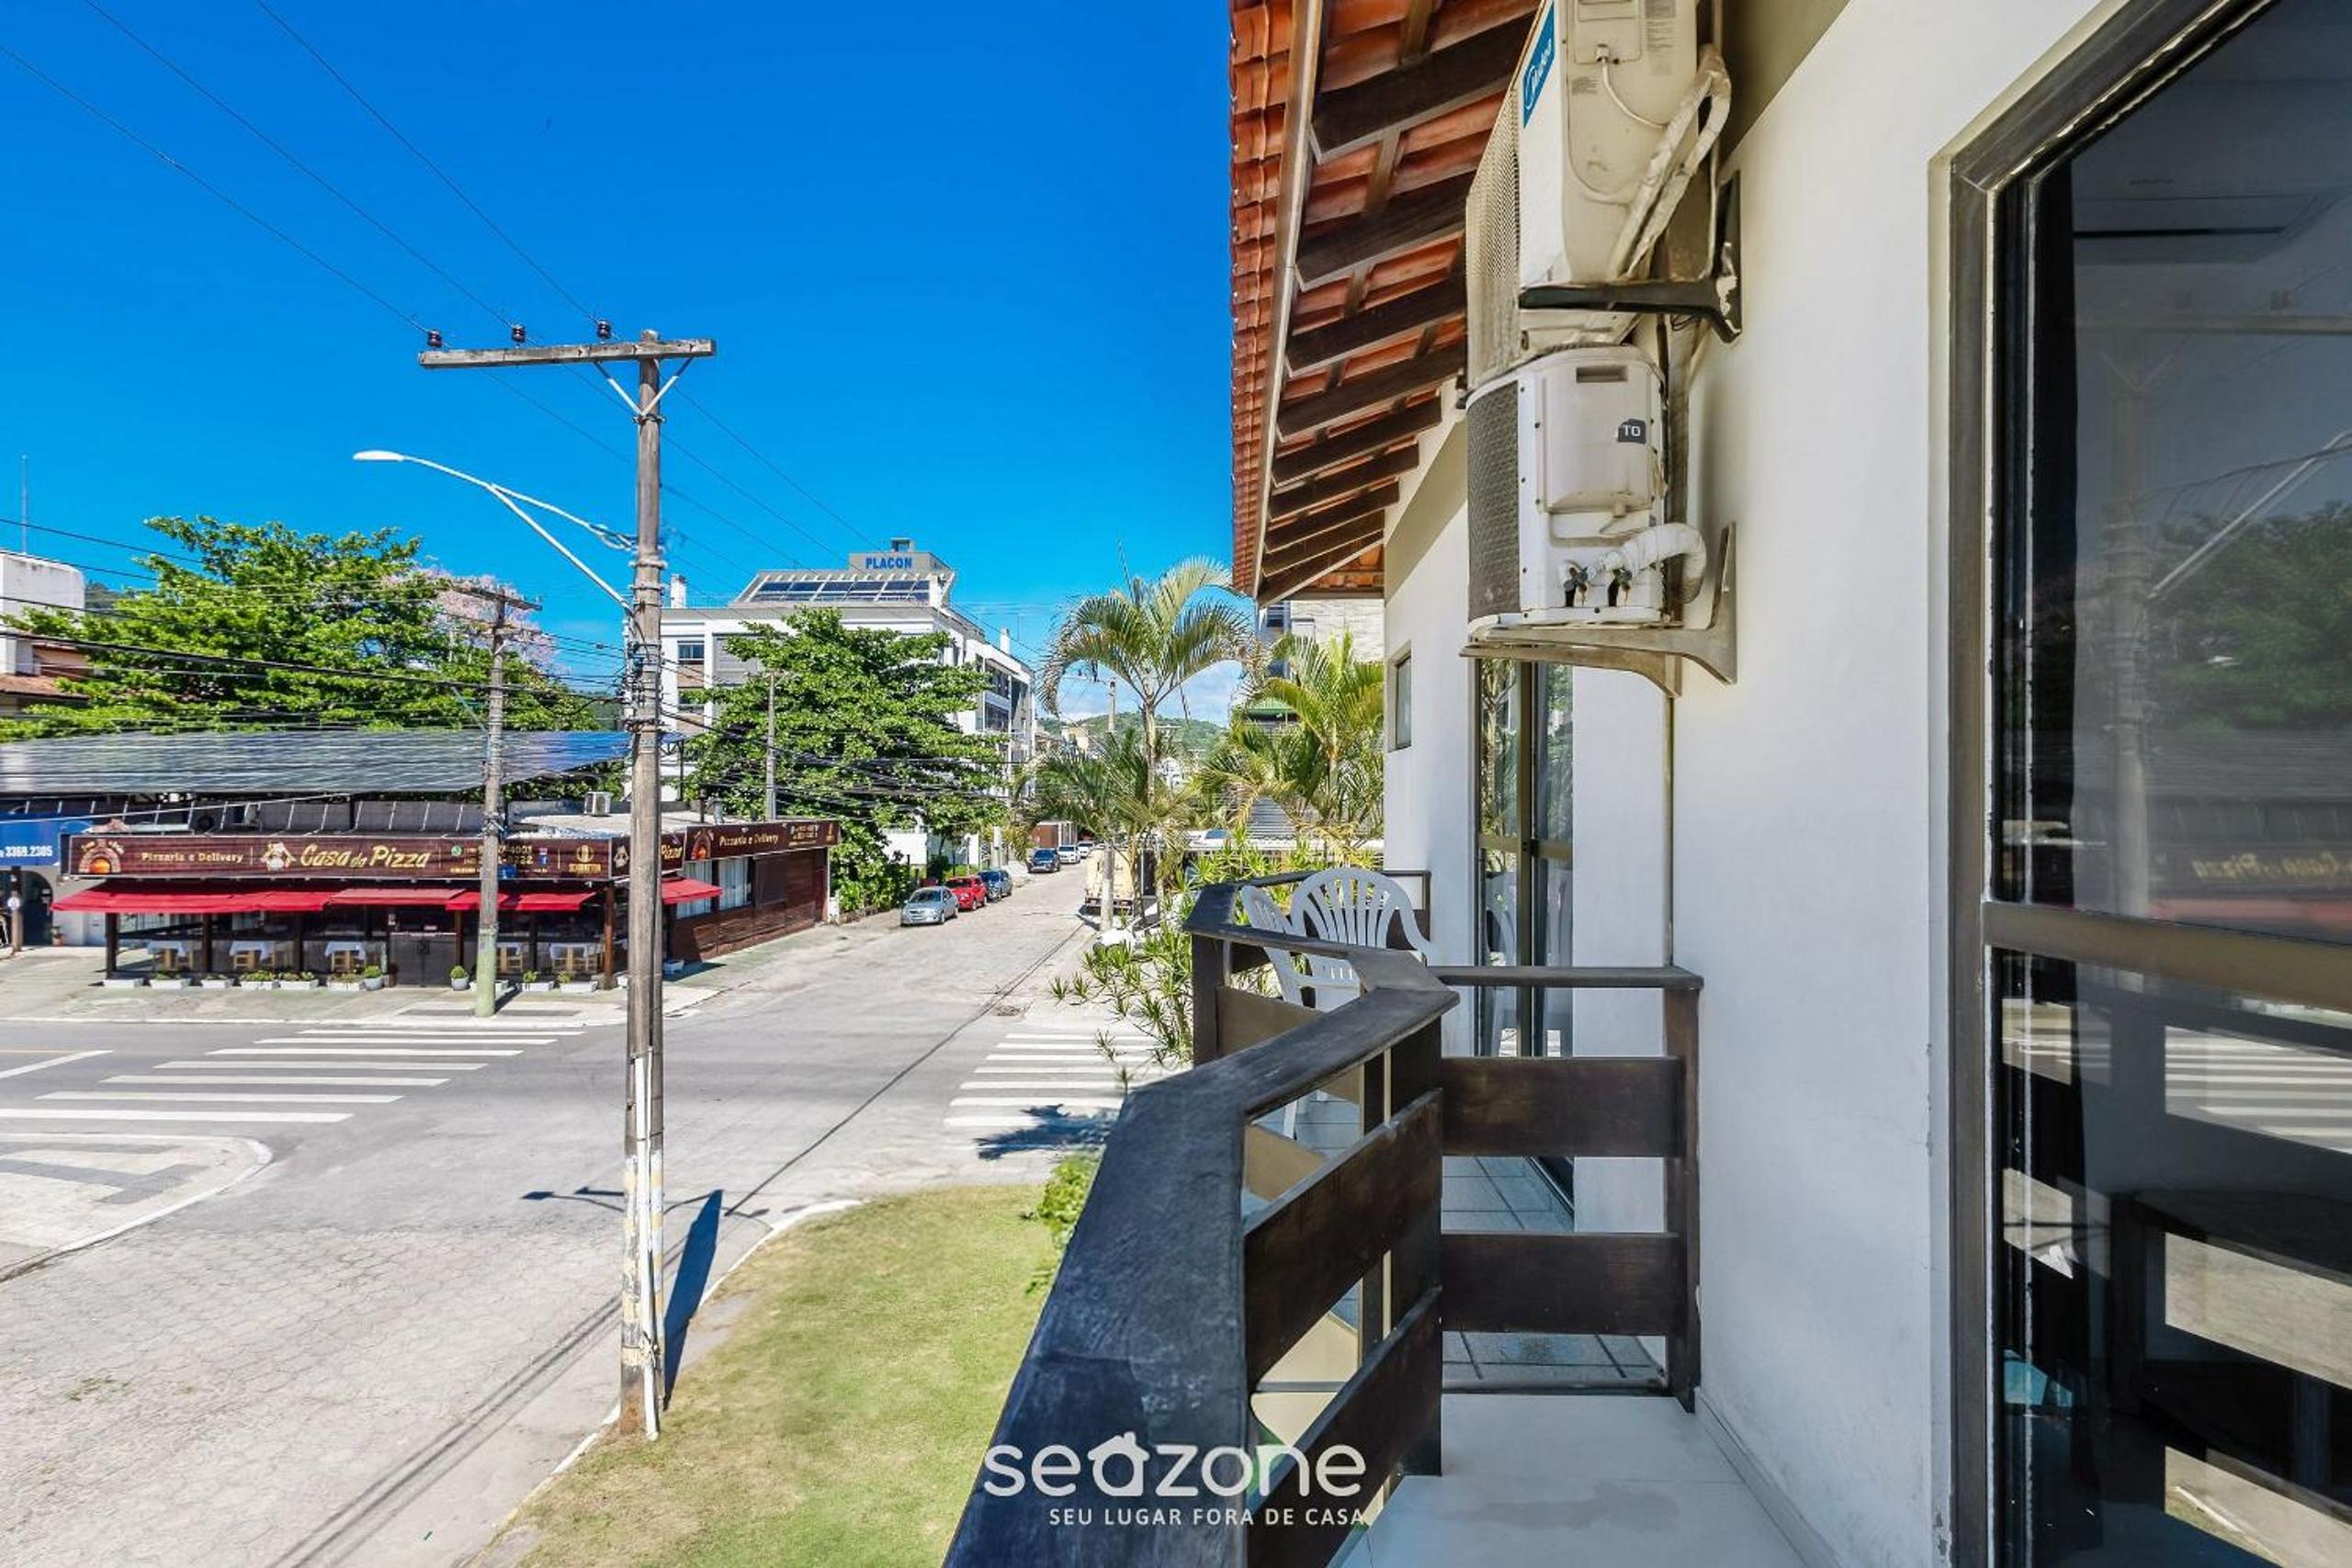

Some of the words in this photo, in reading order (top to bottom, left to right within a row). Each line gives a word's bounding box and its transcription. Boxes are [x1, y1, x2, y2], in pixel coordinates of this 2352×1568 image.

[865, 557, 912, 570] PLACON
[198, 852, 243, 863] Delivery
[300, 843, 352, 867] Casa
[369, 844, 432, 868] Pizza
